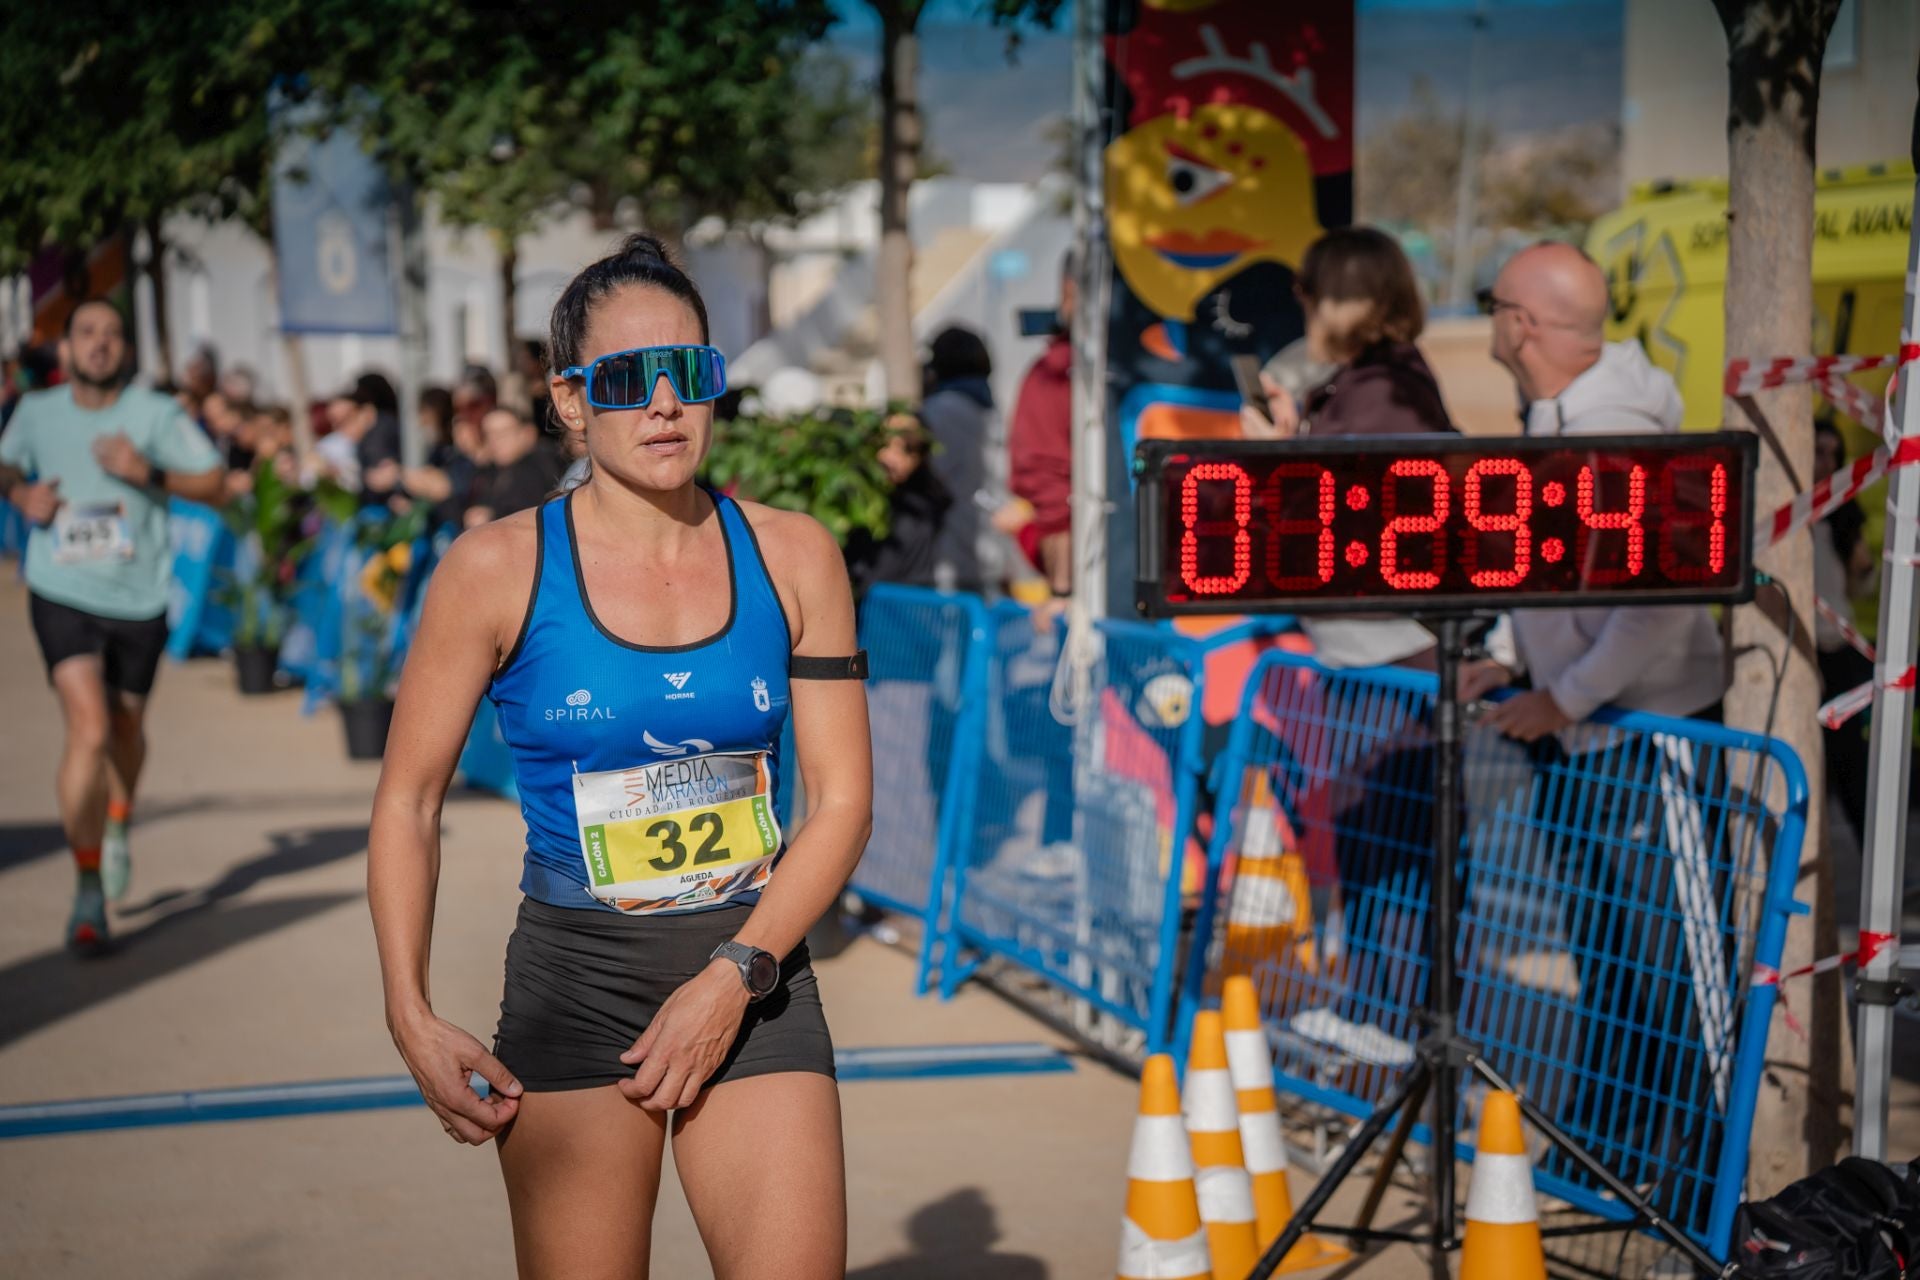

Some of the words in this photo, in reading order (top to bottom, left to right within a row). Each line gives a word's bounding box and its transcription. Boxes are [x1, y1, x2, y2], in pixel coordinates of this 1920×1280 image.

[1181, 458, 1726, 594] 01:29:41
[665, 692, 696, 701] HORME
[544, 706, 617, 721] SPIRAL
[645, 758, 714, 791] MEDIA
[609, 805, 659, 820] CIUDAD
[666, 800, 681, 811] DE
[755, 802, 763, 810] 2
[590, 831, 600, 839] 2
[645, 812, 732, 872] 32
